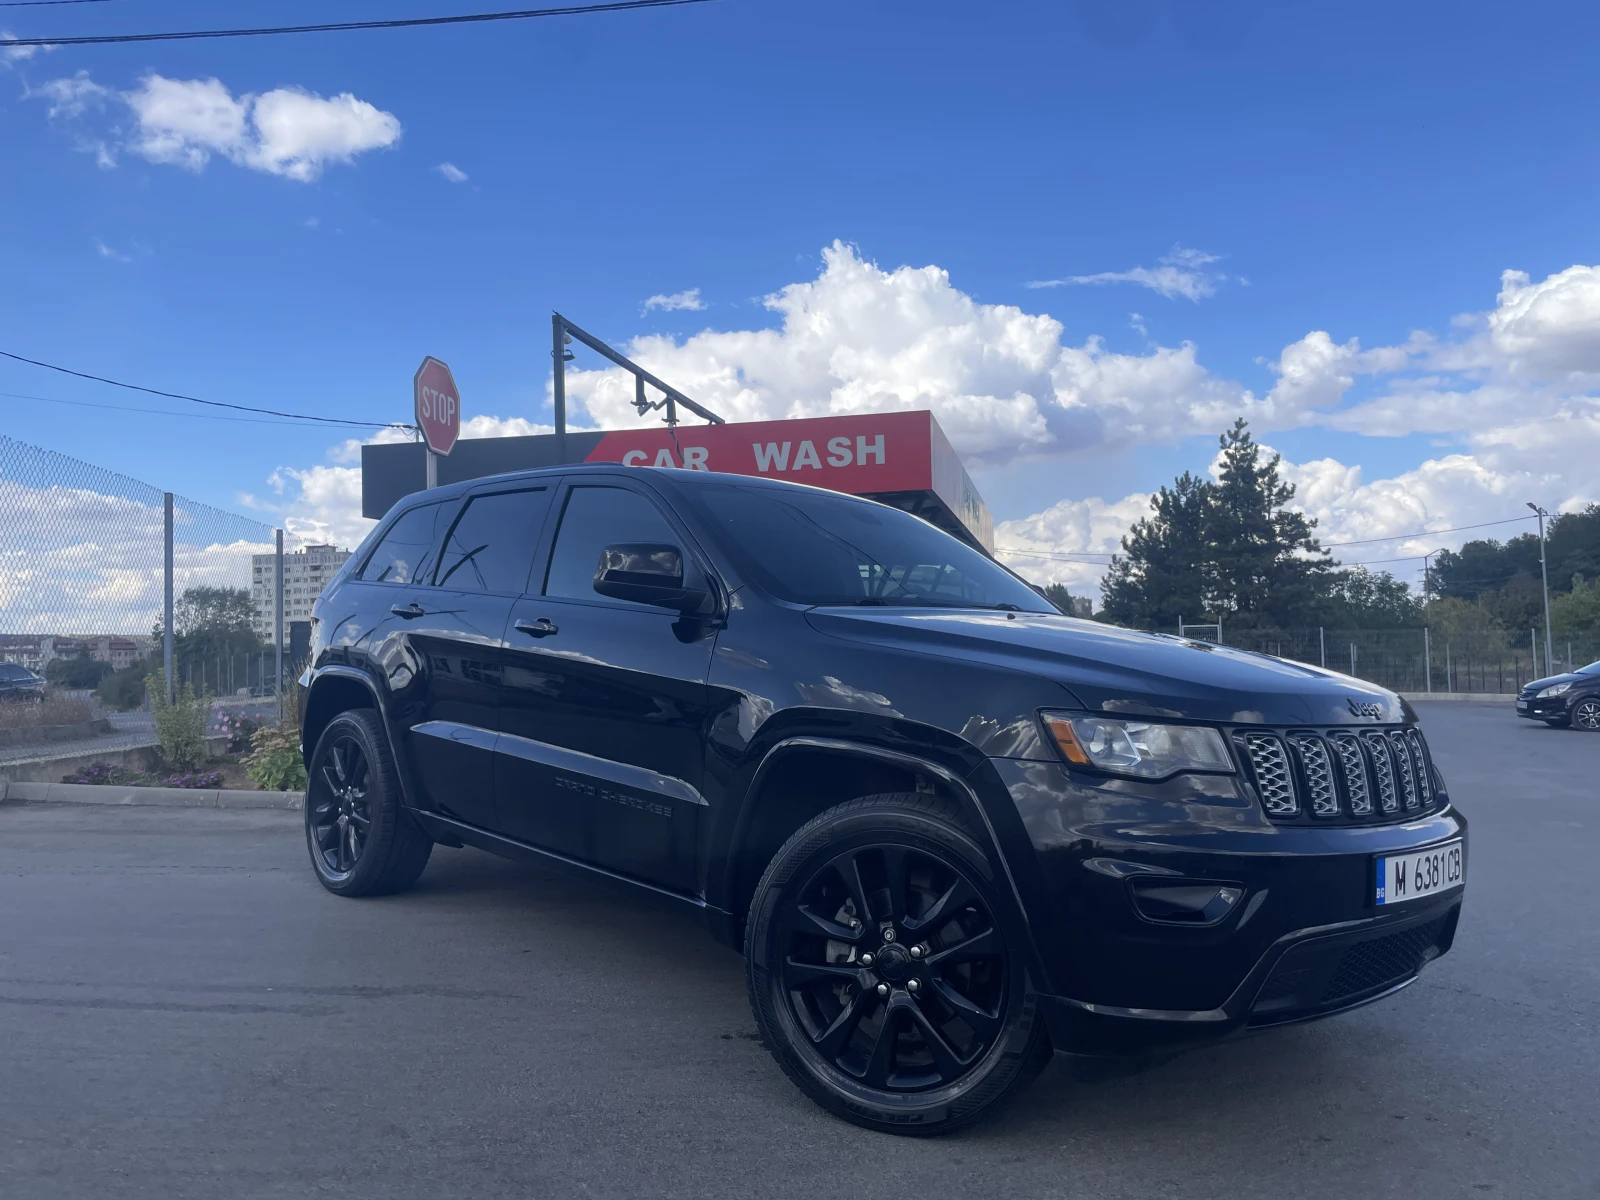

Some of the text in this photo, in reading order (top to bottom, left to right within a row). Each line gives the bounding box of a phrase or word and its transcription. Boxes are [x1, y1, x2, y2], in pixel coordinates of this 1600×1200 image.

[422, 385, 456, 427] STOP
[622, 434, 886, 473] CAR WASH
[1346, 698, 1381, 720] Jeep
[600, 788, 673, 818] CHEROKEE
[1376, 887, 1385, 898] BG
[1395, 860, 1406, 897] M
